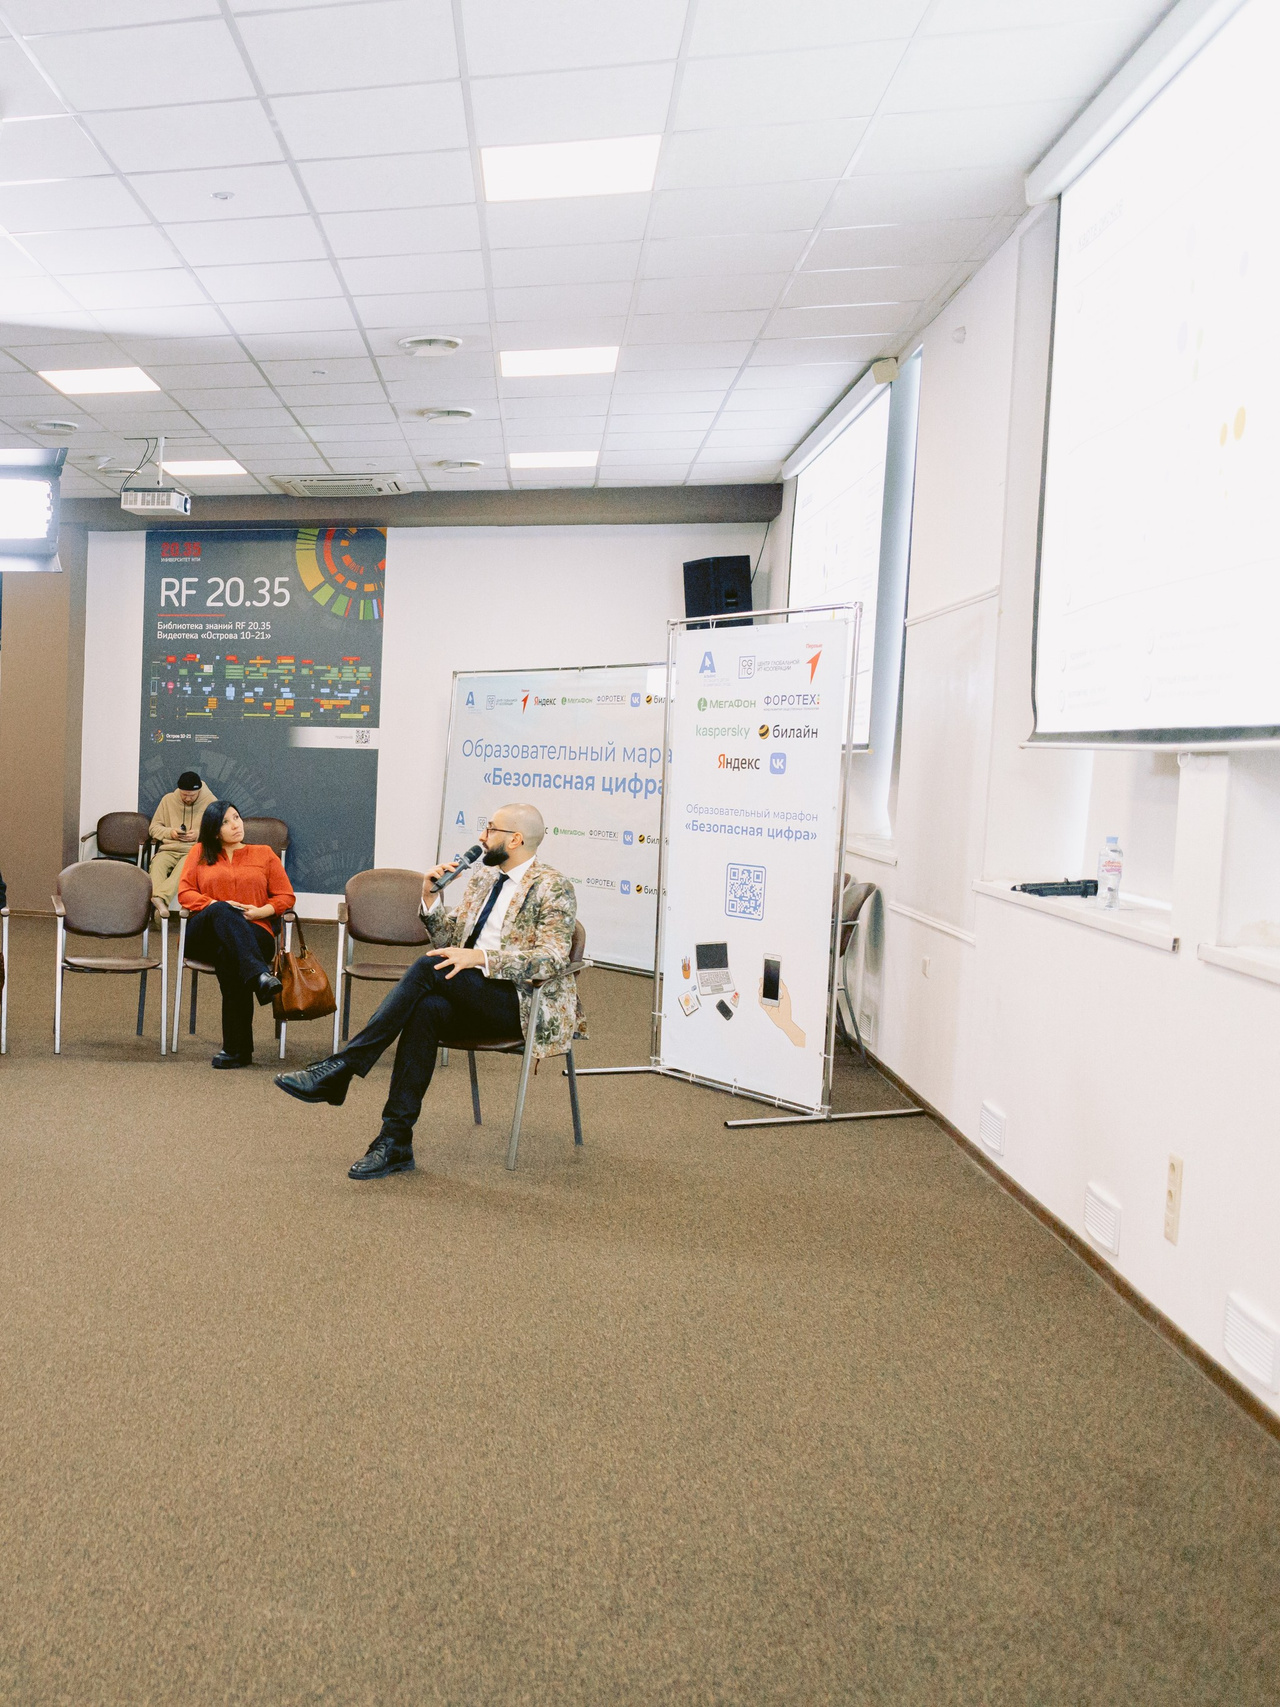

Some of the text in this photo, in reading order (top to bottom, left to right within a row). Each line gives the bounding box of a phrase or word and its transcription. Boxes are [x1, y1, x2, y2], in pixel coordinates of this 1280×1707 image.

[161, 542, 202, 557] 20.35
[161, 576, 291, 607] RF 20.35
[157, 621, 271, 630] Библиотека знаний RF 20.35
[157, 631, 272, 641] Видеотека «Острова 10-21»
[534, 696, 556, 707] Яндекс
[763, 694, 817, 706] ФОРОТЕХ
[695, 724, 751, 739] kaspersky
[772, 724, 818, 739] билайн
[462, 739, 616, 762] Образовательный
[718, 754, 760, 771] Яндекс
[483, 767, 595, 791] «Безопасная
[686, 803, 818, 822] Образовательный марафон
[685, 820, 817, 842] «Безопасная цифра»
